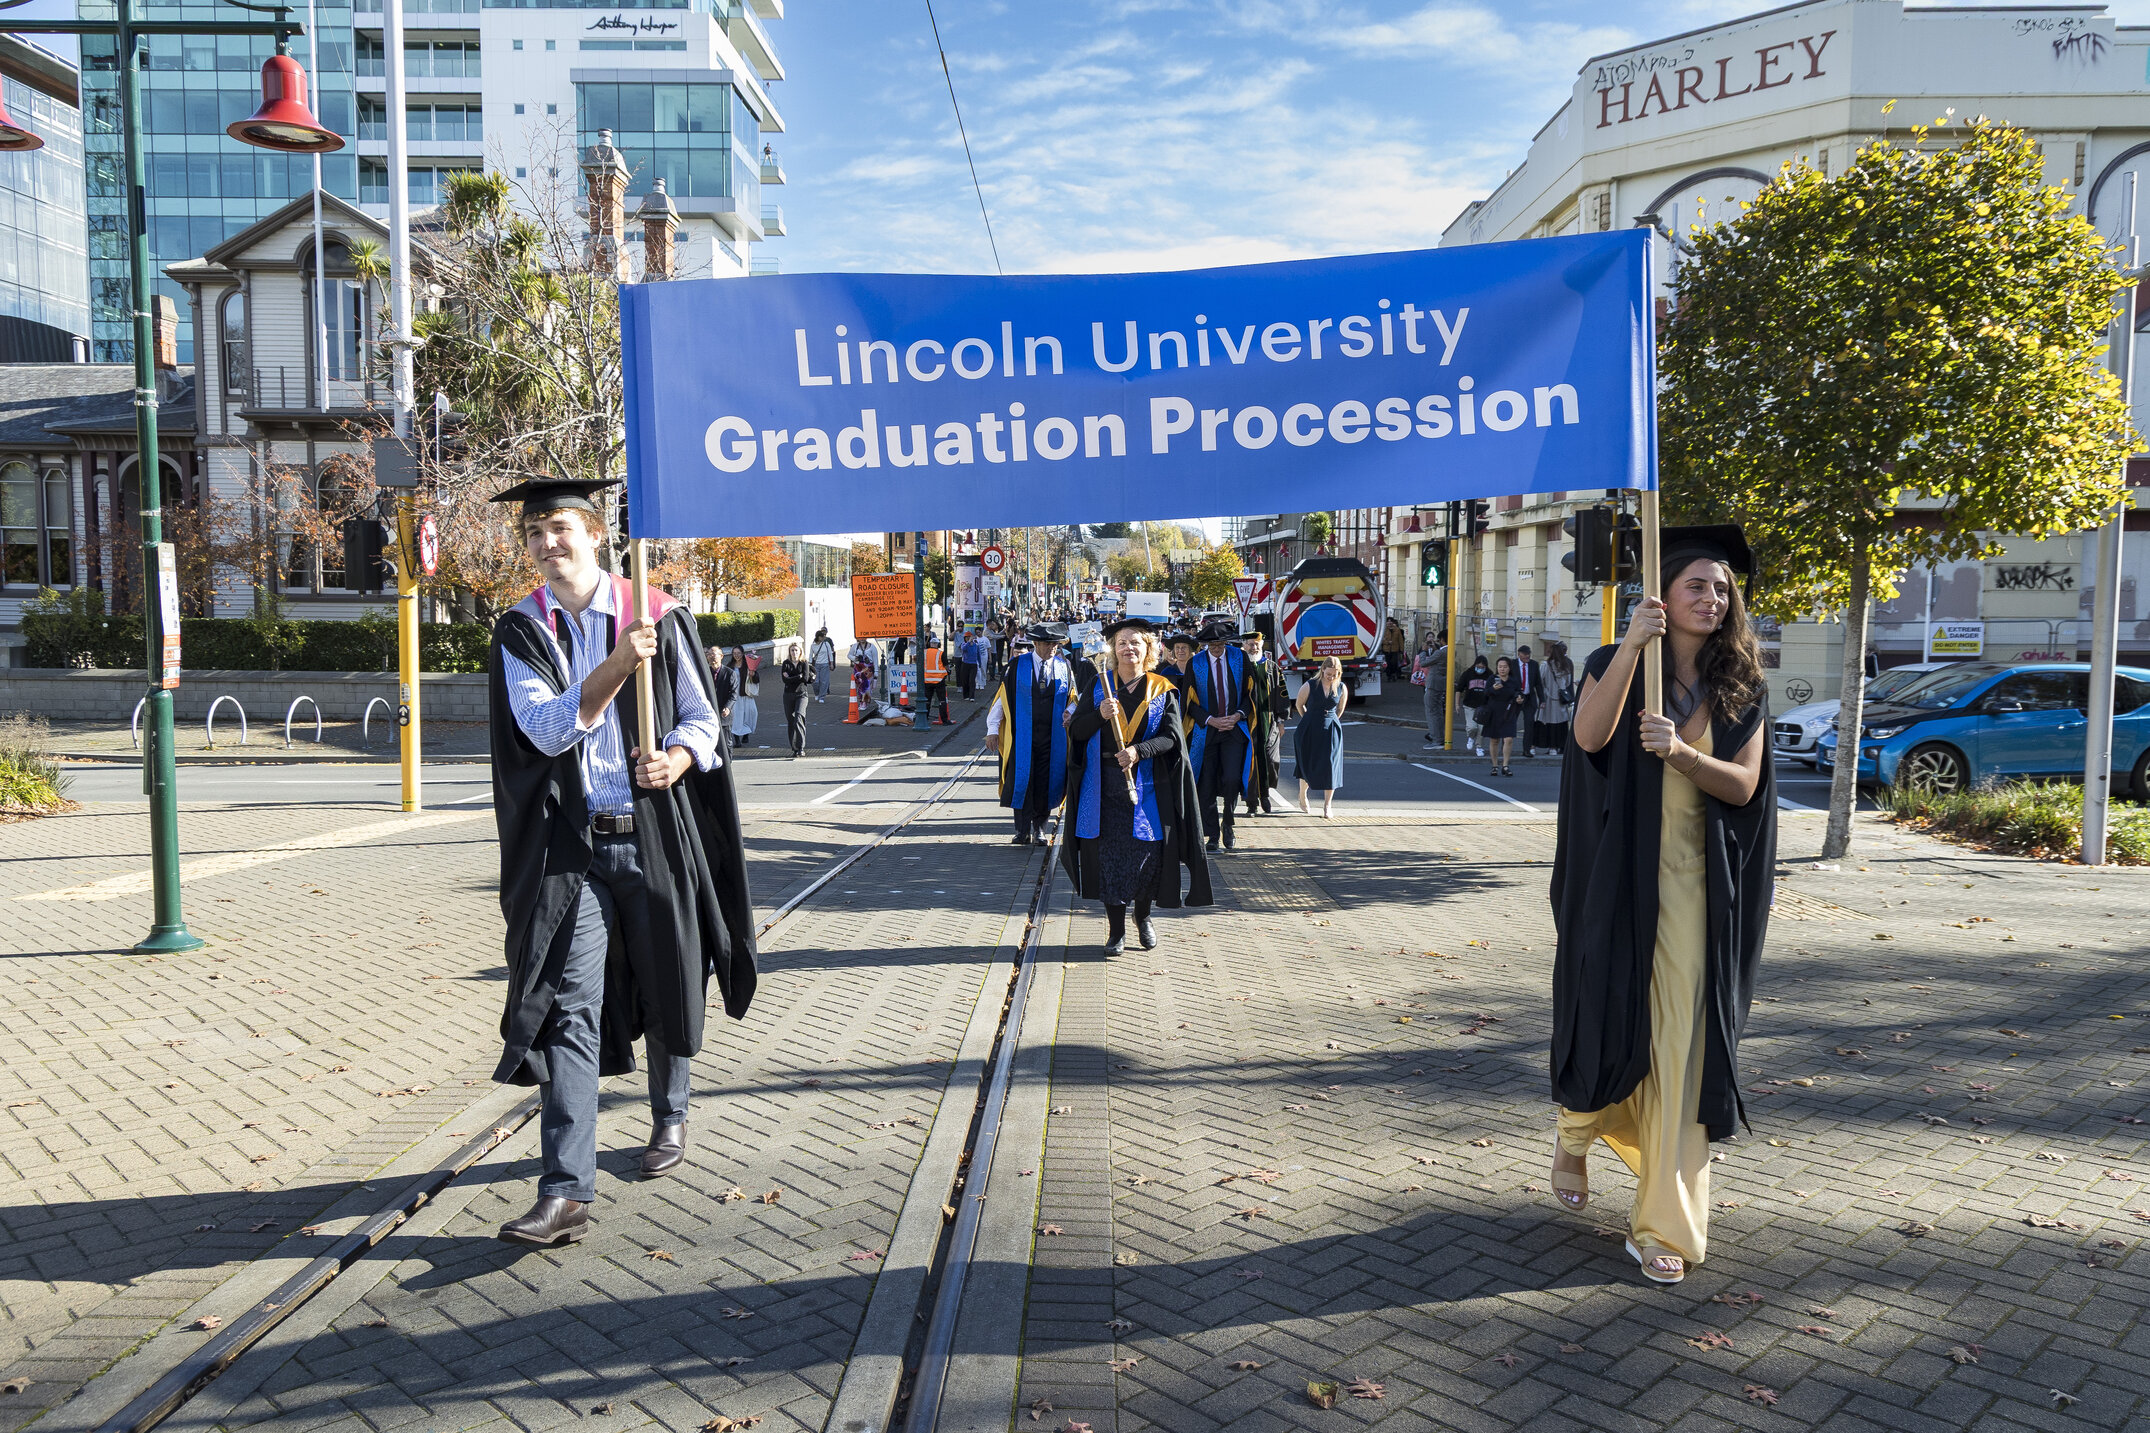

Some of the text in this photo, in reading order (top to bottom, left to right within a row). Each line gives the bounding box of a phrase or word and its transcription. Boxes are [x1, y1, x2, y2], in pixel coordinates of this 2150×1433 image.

[586, 13, 678, 36] Anthony Harper
[1596, 30, 1838, 129] HARLEY
[794, 298, 1470, 387] Lincoln University
[704, 375, 1580, 473] Graduation Procession
[986, 554, 1000, 565] 30
[1239, 585, 1250, 594] GIVE
